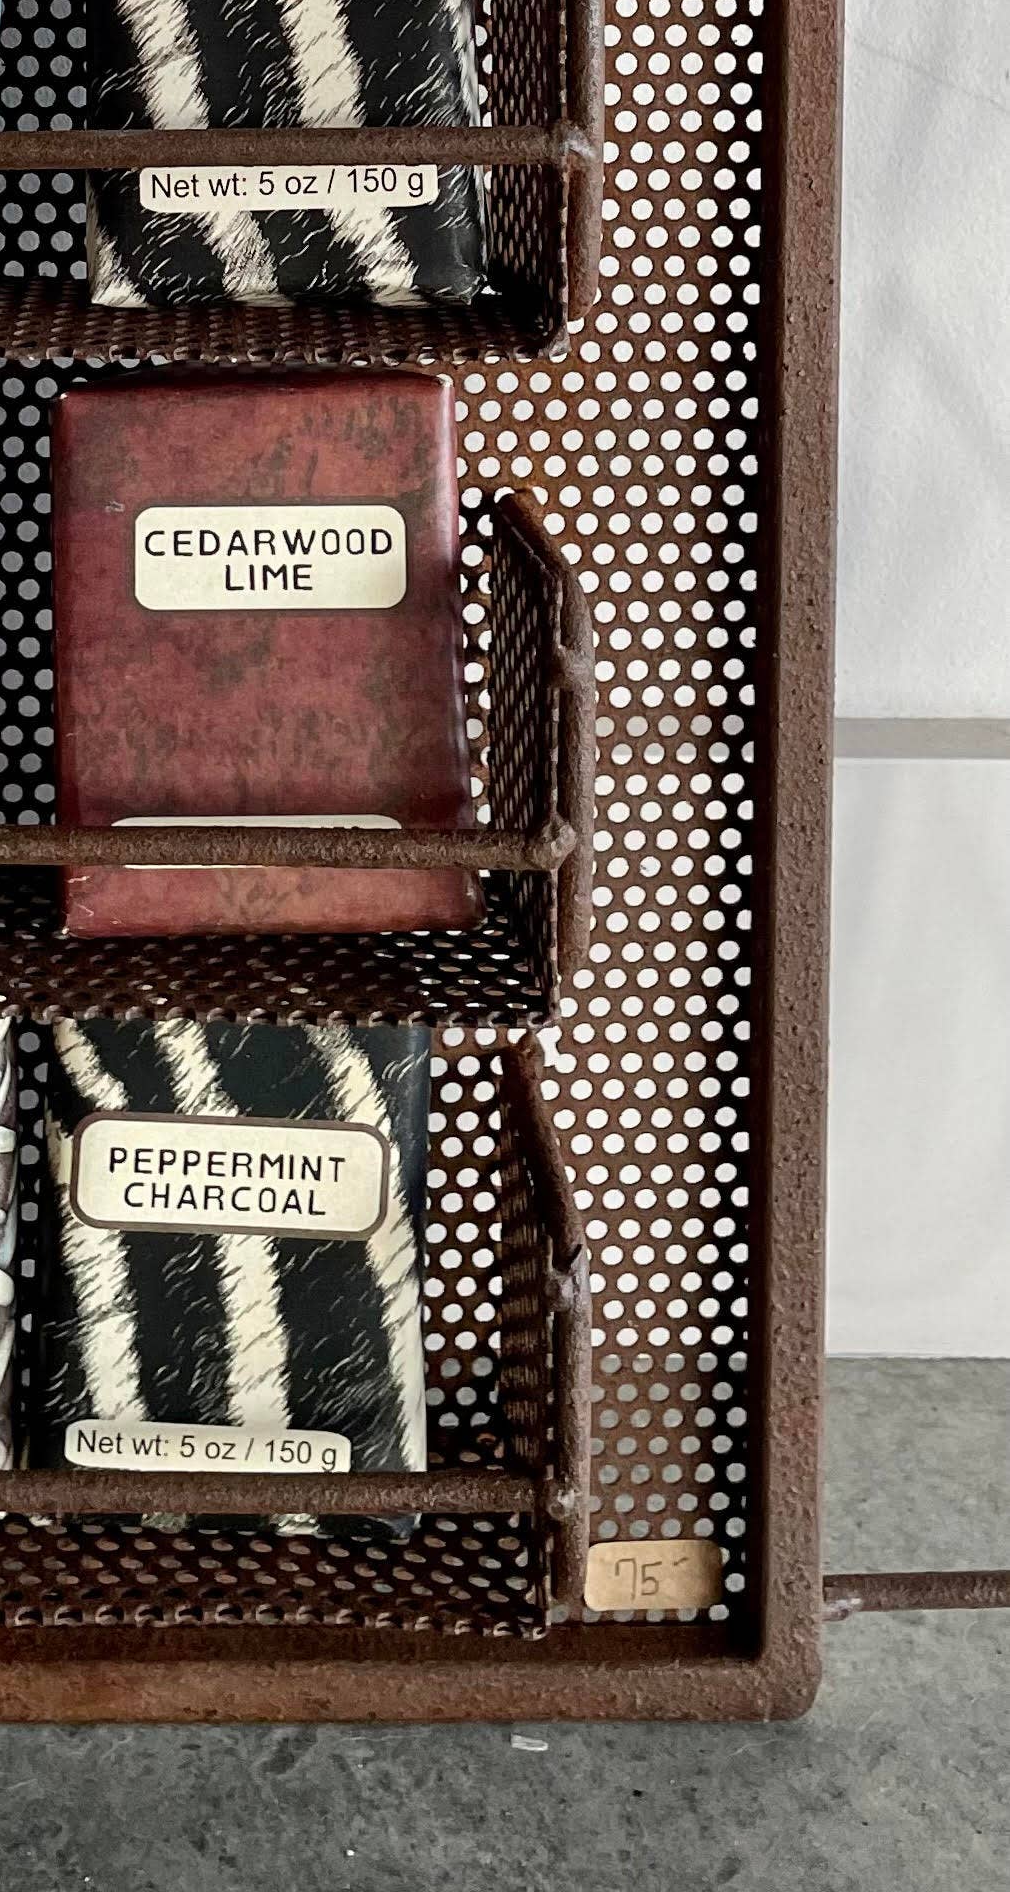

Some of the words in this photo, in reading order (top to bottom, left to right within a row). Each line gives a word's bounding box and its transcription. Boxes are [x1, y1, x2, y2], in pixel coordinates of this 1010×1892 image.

[151, 172, 200, 199] Net
[207, 175, 247, 197] wt:
[258, 170, 275, 196] 5
[284, 175, 319, 195] oz
[326, 168, 336, 194] /
[346, 167, 397, 193] 150
[407, 170, 424, 197] g
[144, 528, 392, 557] CEDARWOOD
[225, 563, 313, 591] LIME
[108, 1146, 346, 1183] PEPPERMINT
[123, 1181, 327, 1217] CHARCOAL
[76, 1429, 123, 1456] Net
[131, 1433, 170, 1458] wt:
[179, 1435, 196, 1458] 5
[204, 1440, 237, 1461] oz
[244, 1437, 255, 1462] /
[264, 1439, 312, 1465] 150
[321, 1445, 337, 1472] g
